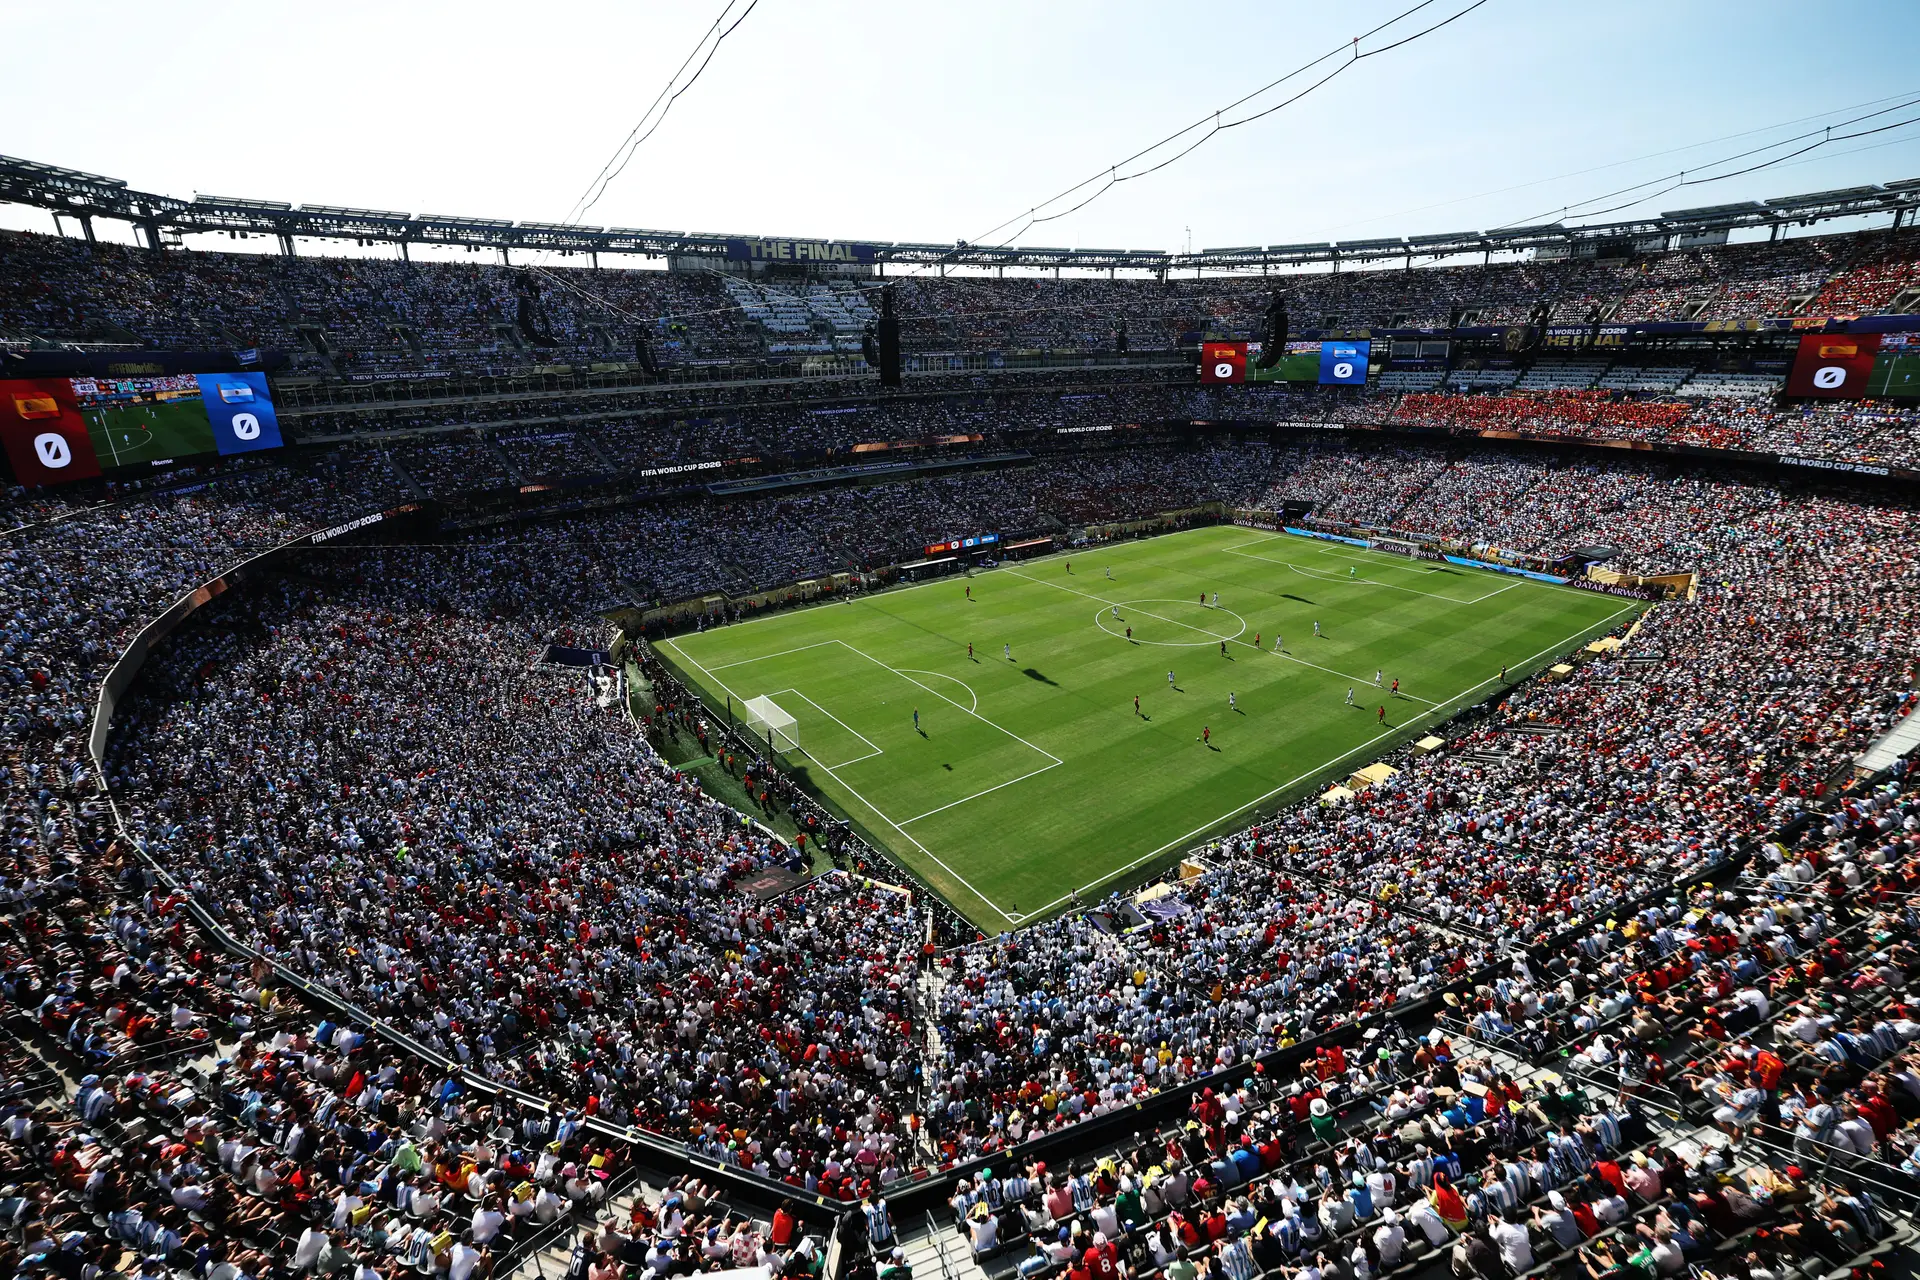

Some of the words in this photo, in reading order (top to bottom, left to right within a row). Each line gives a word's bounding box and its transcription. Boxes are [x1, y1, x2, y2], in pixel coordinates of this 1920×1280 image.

[746, 241, 791, 259] THE
[795, 243, 858, 261] FINAL
[1215, 363, 1233, 378] 0
[1333, 363, 1353, 378] 0
[1813, 366, 1847, 389] 0
[232, 413, 260, 440] 0
[33, 433, 71, 468] 0
[151, 458, 173, 466] Hisense
[641, 469, 657, 477] FIFA
[657, 466, 683, 475] WORLD
[698, 461, 722, 469] 2026
[1779, 456, 1799, 465] FIFA
[1799, 458, 1833, 469] WORLD
[1834, 462, 1853, 471] CUP
[1854, 464, 1889, 476] 2026
[311, 531, 328, 543] FIFA
[327, 525, 349, 537] WORLD
[348, 520, 361, 531] CUP
[360, 513, 383, 526] 2026
[1384, 544, 1407, 554] QATAR
[1409, 548, 1439, 560] AIRWAYS
[1573, 580, 1604, 592] QATAR
[1607, 585, 1648, 600] AIRWAYS
[1394, 1026, 1405, 1040] 10
[1533, 1038, 1545, 1052] 10
[1259, 1080, 1271, 1093] 20
[540, 1118, 551, 1134] 10
[1522, 1122, 1536, 1139] 10
[1446, 1161, 1461, 1178] 10
[985, 1188, 998, 1202] 10
[1077, 1185, 1090, 1202] 10
[872, 1211, 884, 1228] 10
[410, 1240, 421, 1258] 10
[569, 1255, 583, 1276] 10
[1101, 1258, 1111, 1273] 8
